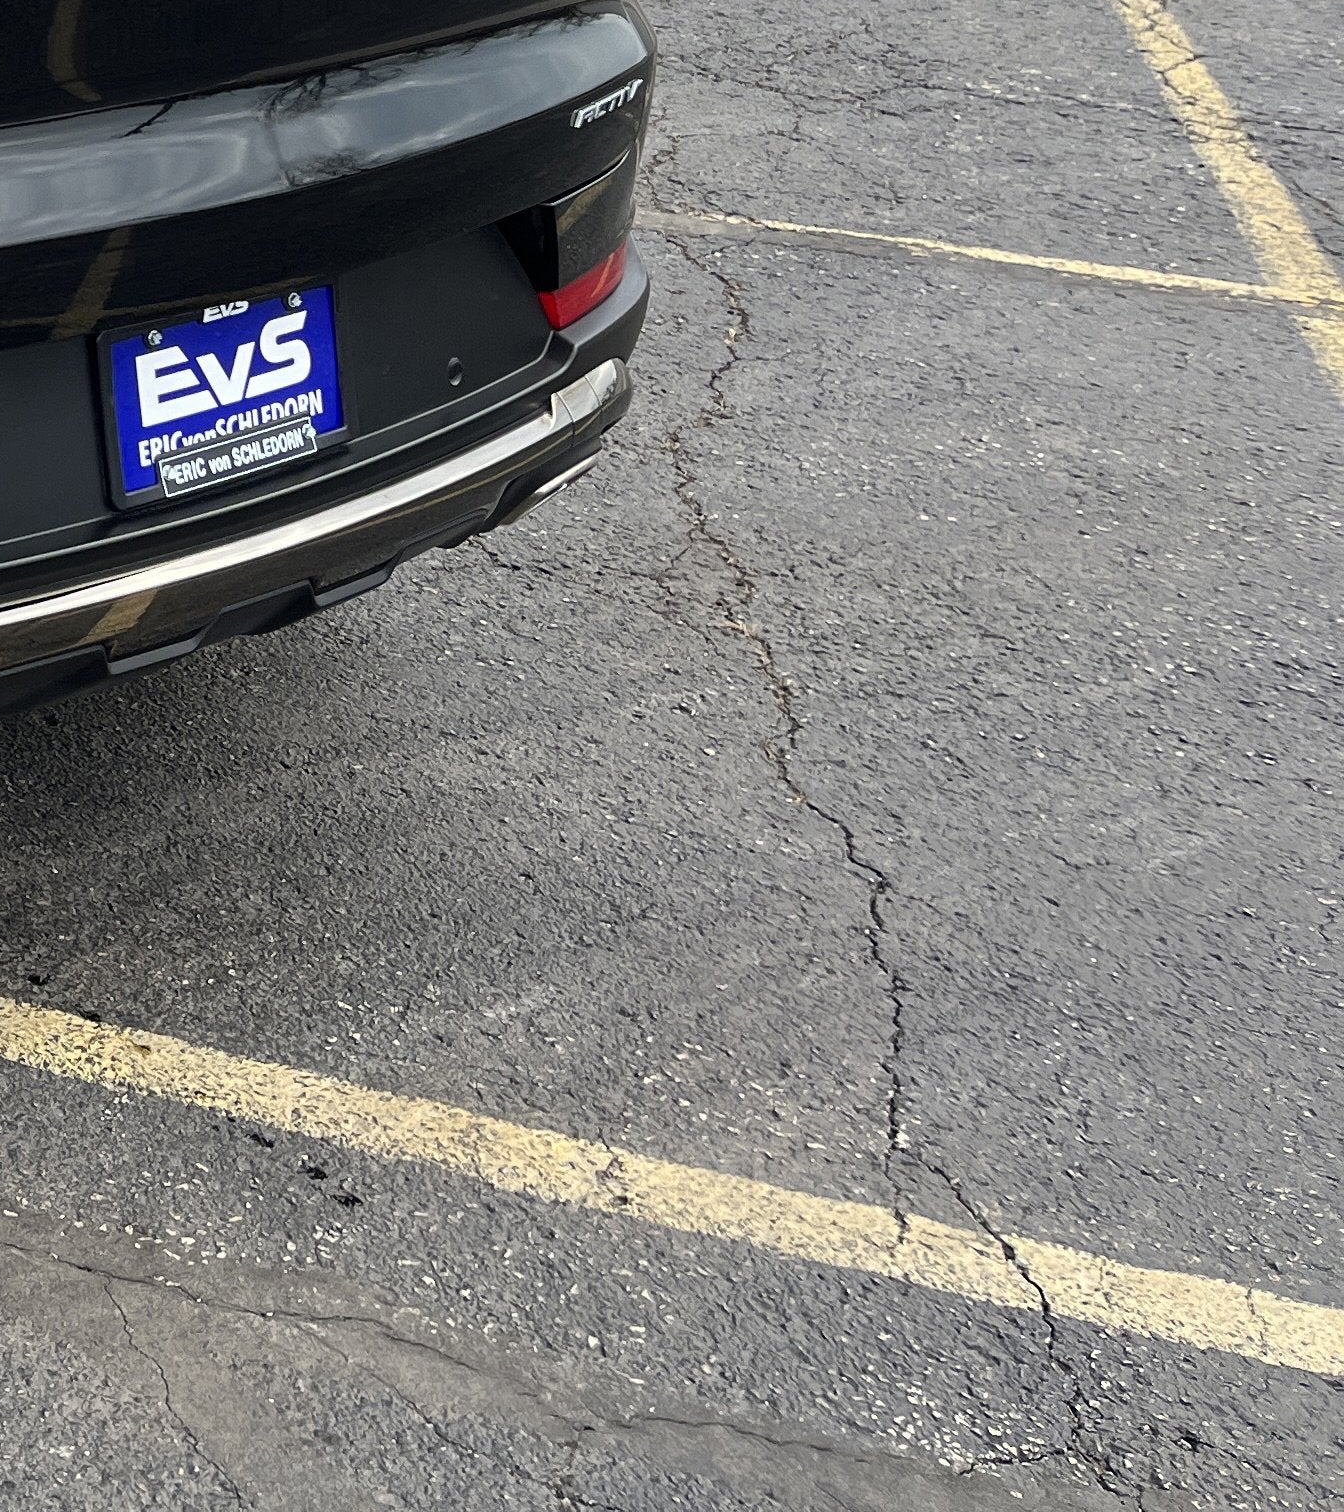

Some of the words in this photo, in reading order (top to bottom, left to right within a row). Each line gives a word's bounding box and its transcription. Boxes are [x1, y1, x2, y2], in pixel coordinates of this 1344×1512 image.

[569, 78, 644, 129] ACTIV
[173, 457, 207, 486] ERIC
[207, 454, 232, 476] von
[231, 427, 305, 468] SCHLEDORN
